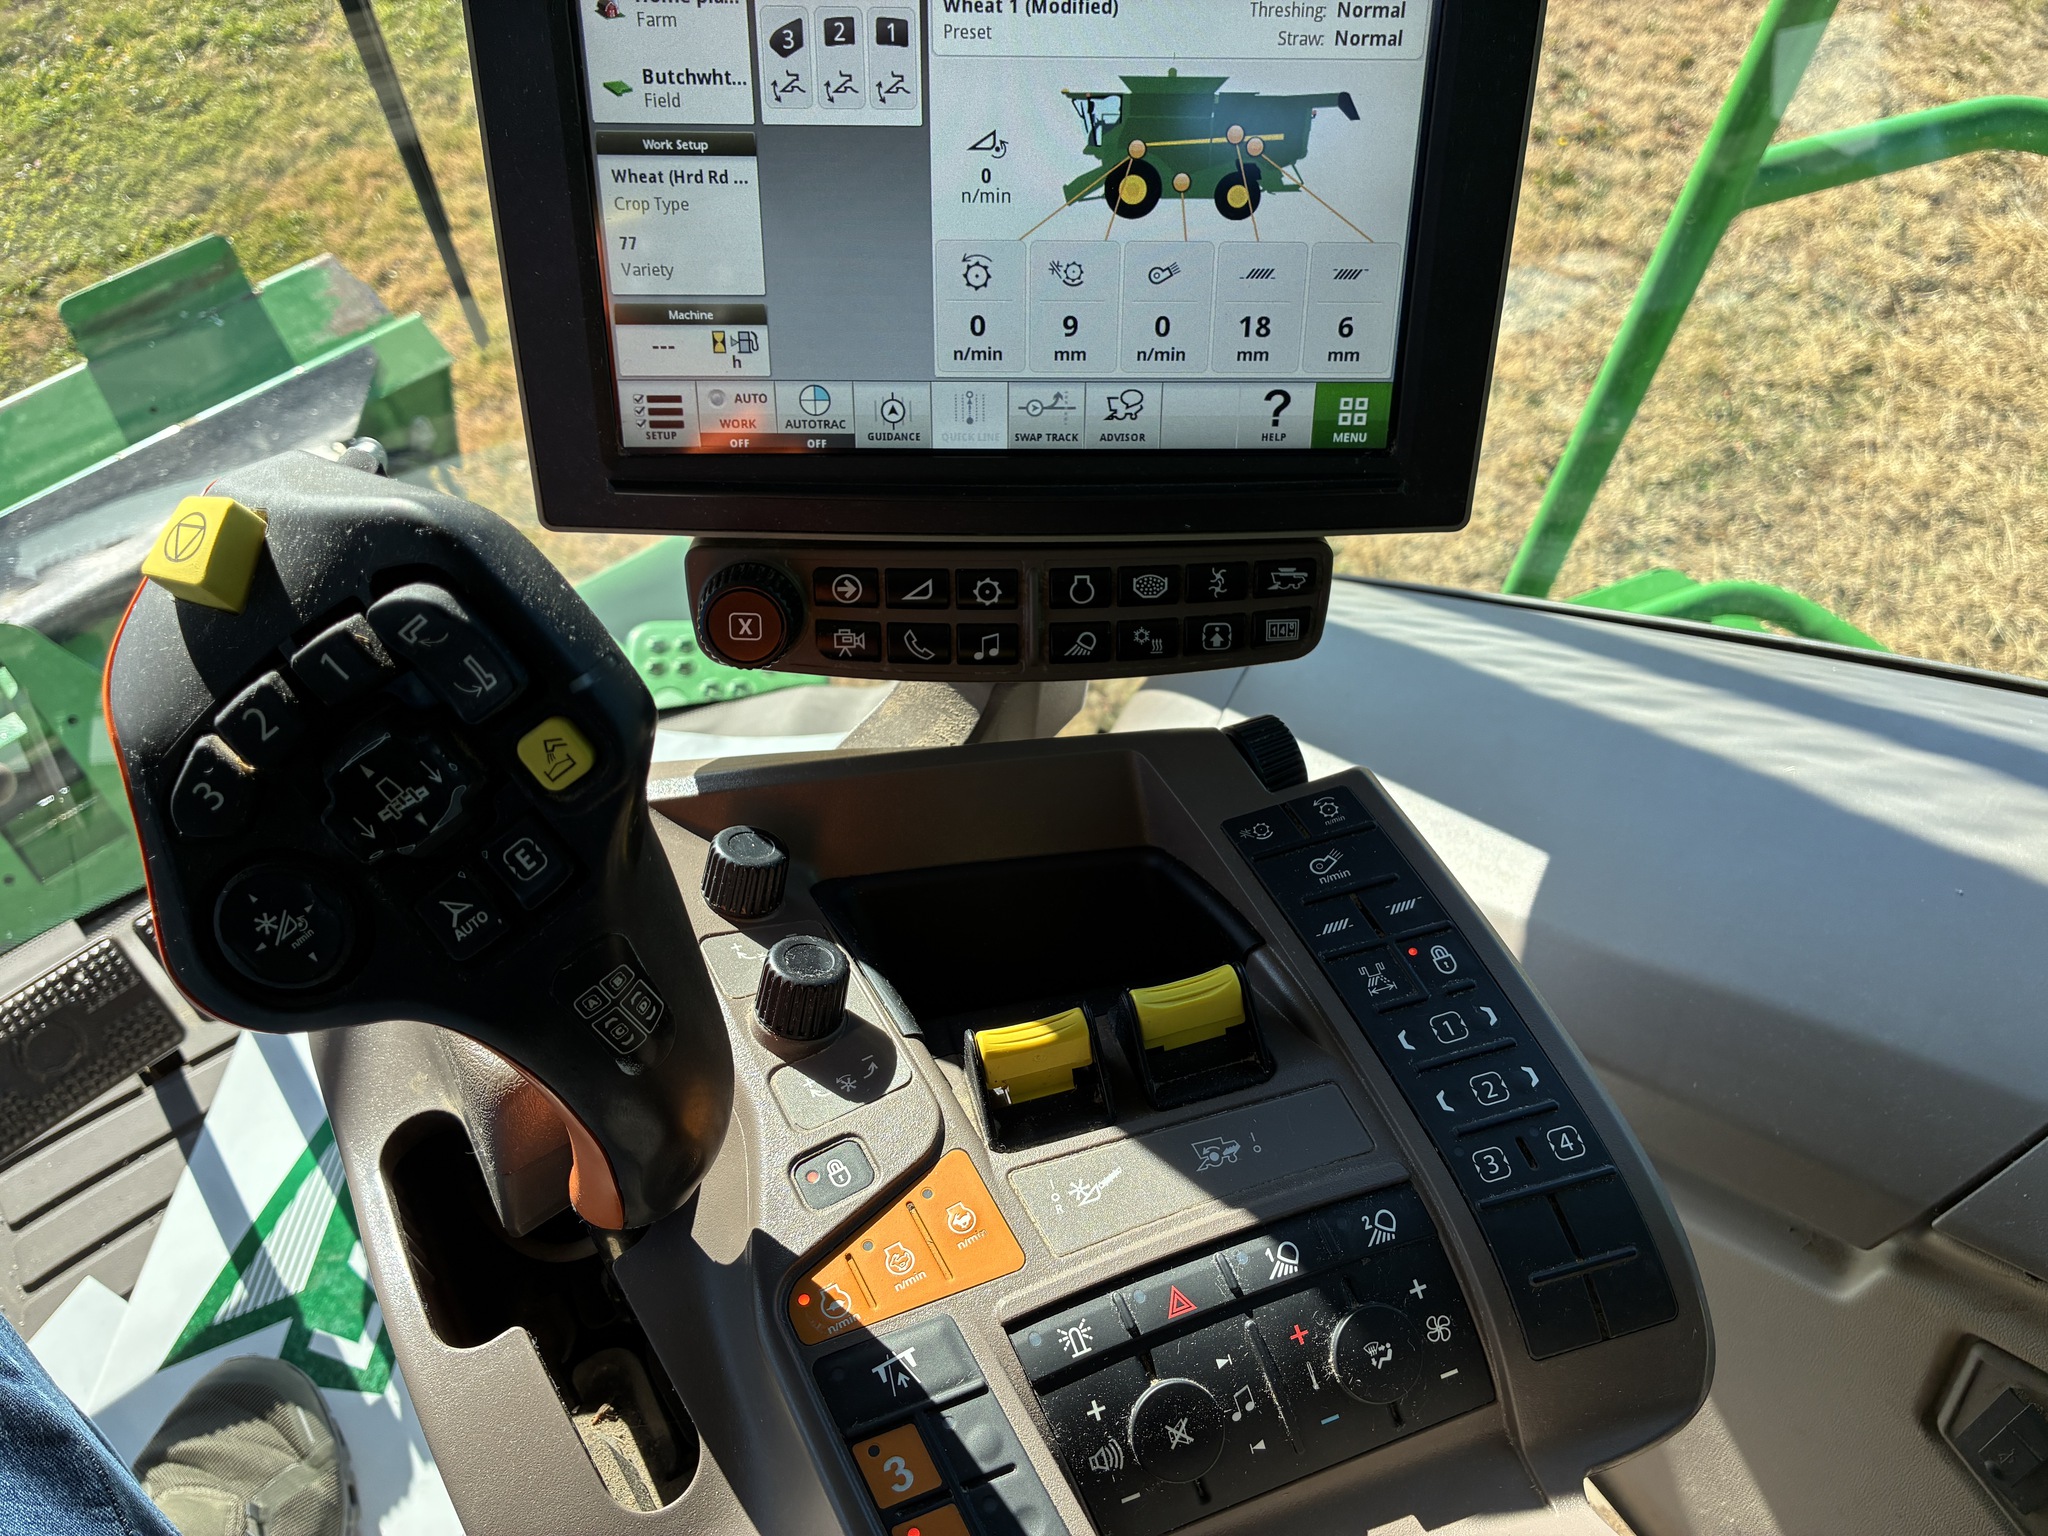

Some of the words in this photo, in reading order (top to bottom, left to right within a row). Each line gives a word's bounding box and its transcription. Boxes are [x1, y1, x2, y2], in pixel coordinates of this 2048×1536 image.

[944, 0, 1003, 14] Wheat
[1010, 0, 1018, 14] 1
[1025, 0, 1120, 18] (Modified)
[1251, 1, 1326, 23] Threshing:
[1337, 1, 1406, 19] Normal
[637, 11, 678, 28] Farm
[783, 30, 795, 50] 3
[834, 22, 846, 42] 2
[886, 22, 896, 42] 1
[943, 23, 993, 40] Preset
[1277, 30, 1325, 47] Straw:
[1334, 30, 1404, 47] Normal
[644, 92, 682, 109] Field
[642, 138, 673, 151] Work
[676, 138, 709, 154] Setup
[611, 168, 665, 185] Wheat
[669, 169, 704, 187] (Hrd
[708, 170, 730, 186] Rd
[980, 167, 992, 184] 0
[614, 196, 650, 214] Crop
[653, 196, 690, 213] Type
[961, 188, 1012, 205] n/min
[619, 236, 637, 251] 77
[621, 262, 674, 281] Variety
[668, 309, 714, 321] Machine
[970, 314, 986, 338] 0
[1062, 315, 1079, 338] 9
[1155, 315, 1171, 338] 0
[1239, 315, 1271, 338] 18
[1338, 316, 1354, 339] 6
[953, 348, 1003, 362] n/min
[1053, 350, 1087, 362] mm
[1136, 348, 1186, 363] n/min
[1236, 350, 1269, 362] mm
[1327, 350, 1360, 363] mm
[734, 391, 768, 404] AUTO
[719, 418, 757, 430] WORK
[785, 418, 847, 431] AUTOTRAC
[646, 430, 677, 441] SETUP
[729, 438, 751, 449] OFF
[806, 438, 828, 449] OFF
[867, 431, 921, 443] GUIDANCE
[1014, 432, 1045, 443] SWAP
[1048, 432, 1079, 443] TRACK
[1099, 432, 1146, 443] ADVISOR
[1261, 431, 1287, 443] HELP
[1332, 431, 1368, 443] MENU
[738, 618, 753, 635] X
[319, 651, 349, 682] 1
[242, 707, 280, 742] 2
[192, 782, 225, 811] 3
[515, 848, 536, 872] E
[1318, 866, 1352, 885] n/min
[454, 910, 489, 943] AUTO
[1442, 1020, 1454, 1036] 1
[1480, 1079, 1499, 1101] 2
[1558, 1132, 1575, 1153] 4
[1484, 1153, 1501, 1176] 3
[1361, 1215, 1372, 1230] 2
[1265, 1247, 1274, 1263] 1
[894, 1270, 927, 1292] n/min
[827, 1312, 861, 1335] n/min
[883, 1456, 914, 1492] 3
